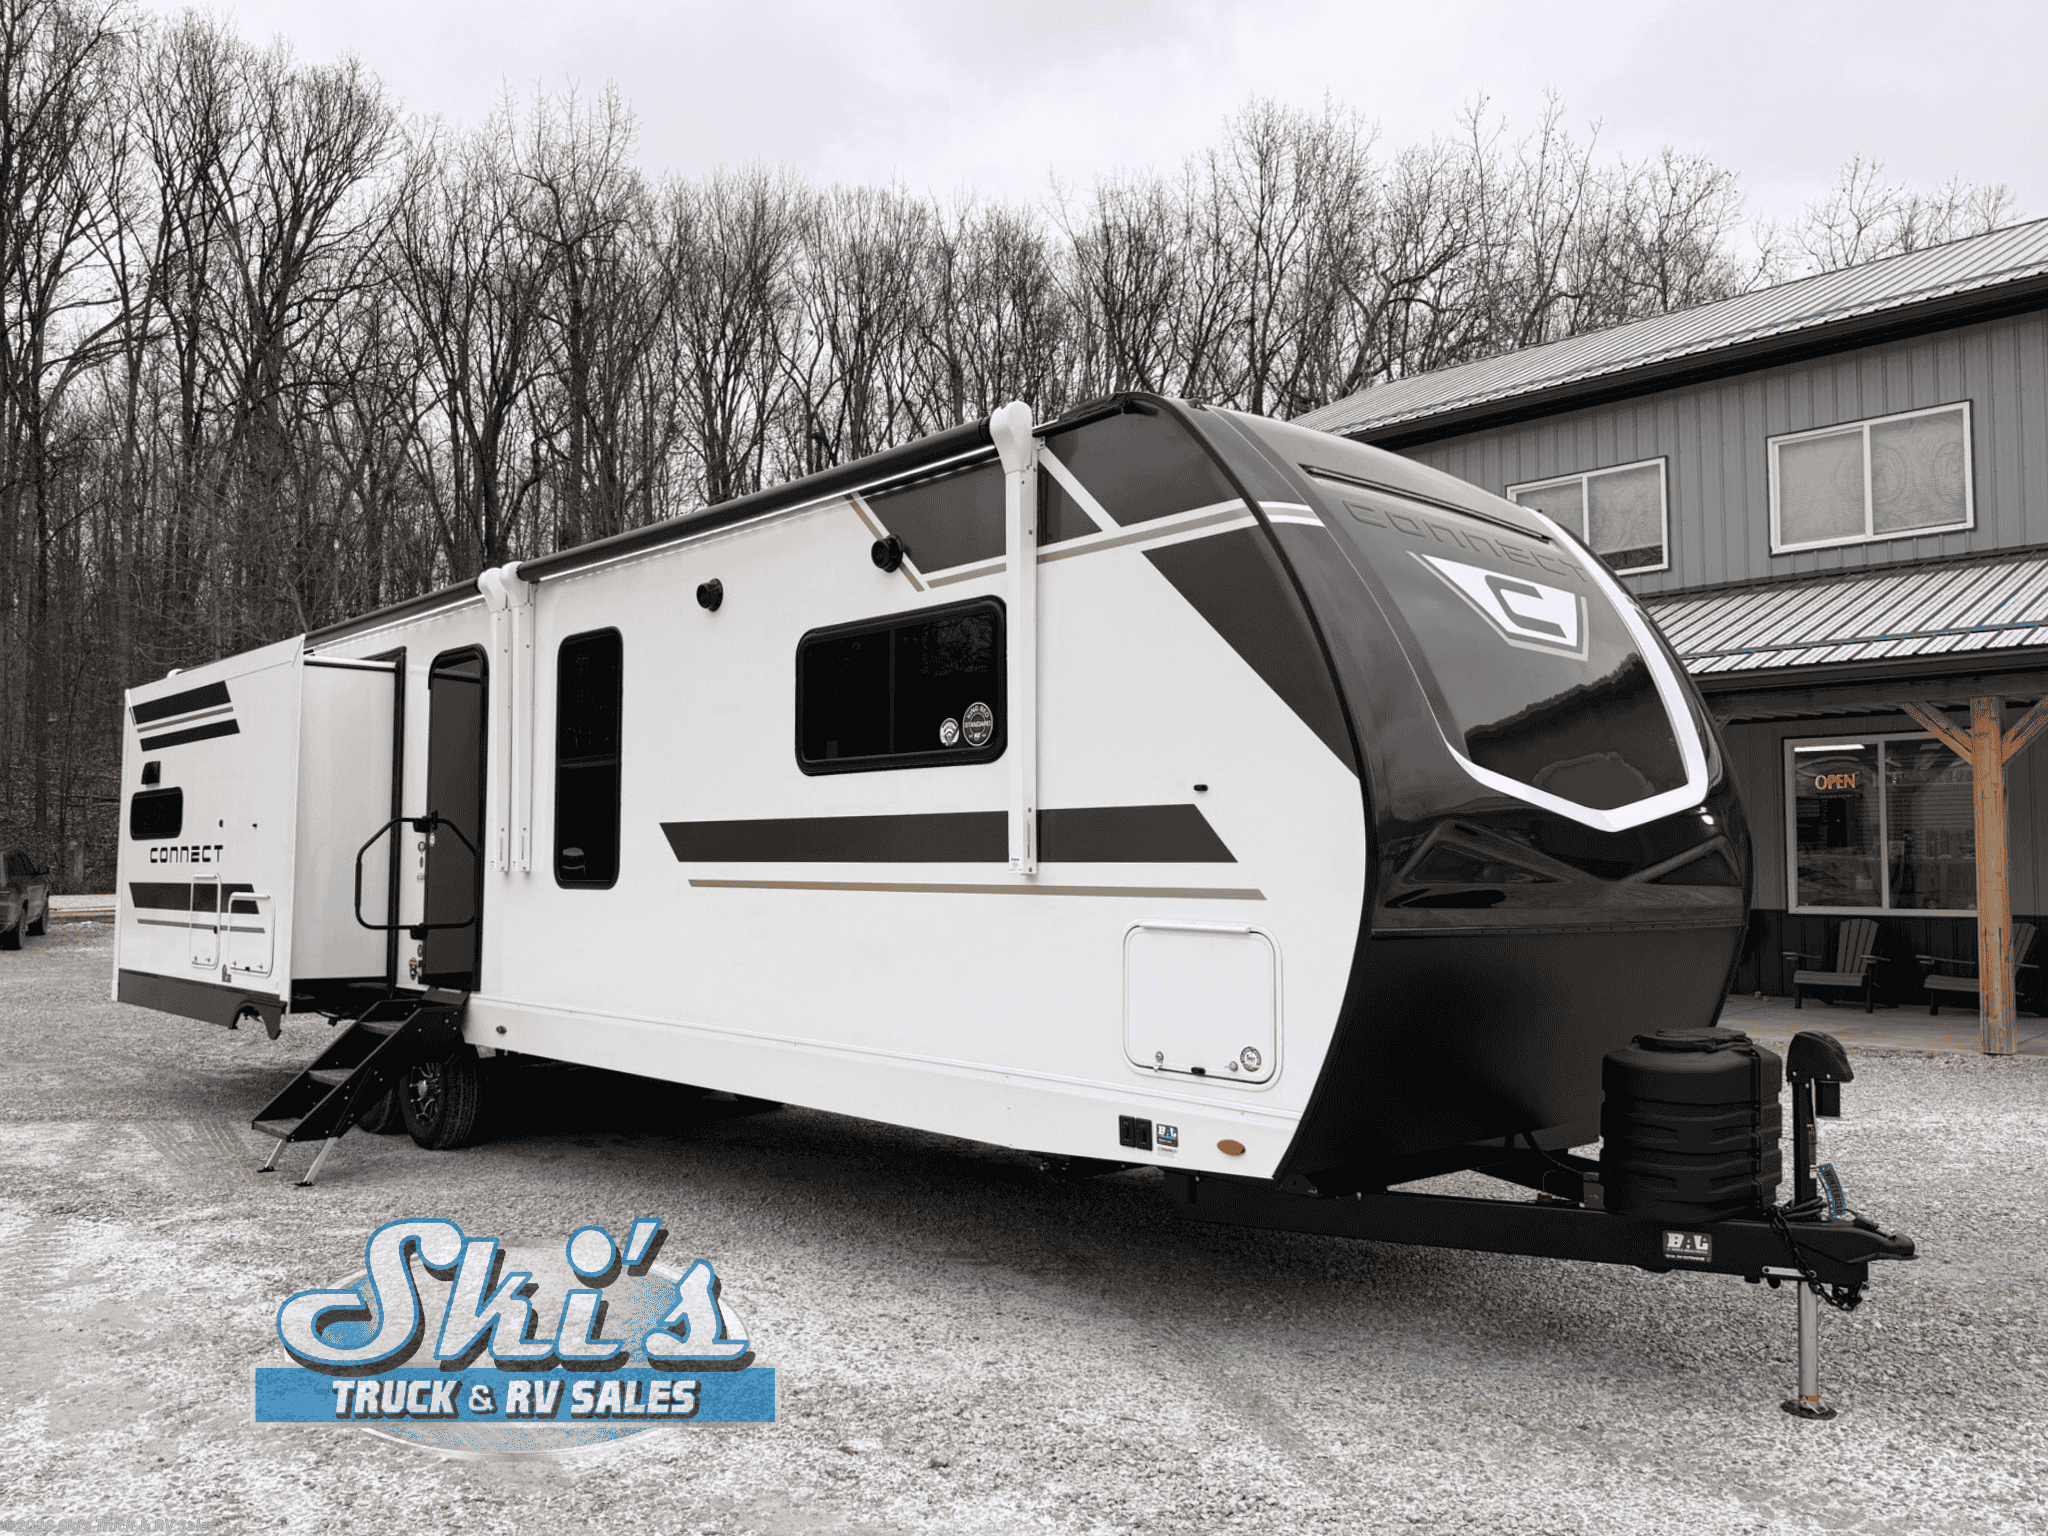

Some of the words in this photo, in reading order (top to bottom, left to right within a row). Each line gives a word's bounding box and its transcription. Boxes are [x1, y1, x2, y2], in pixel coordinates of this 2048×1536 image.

[964, 720, 991, 729] STANDARD
[1815, 773, 1856, 790] OPEN
[149, 844, 224, 863] CONNECT
[1667, 1232, 1709, 1250] BAL
